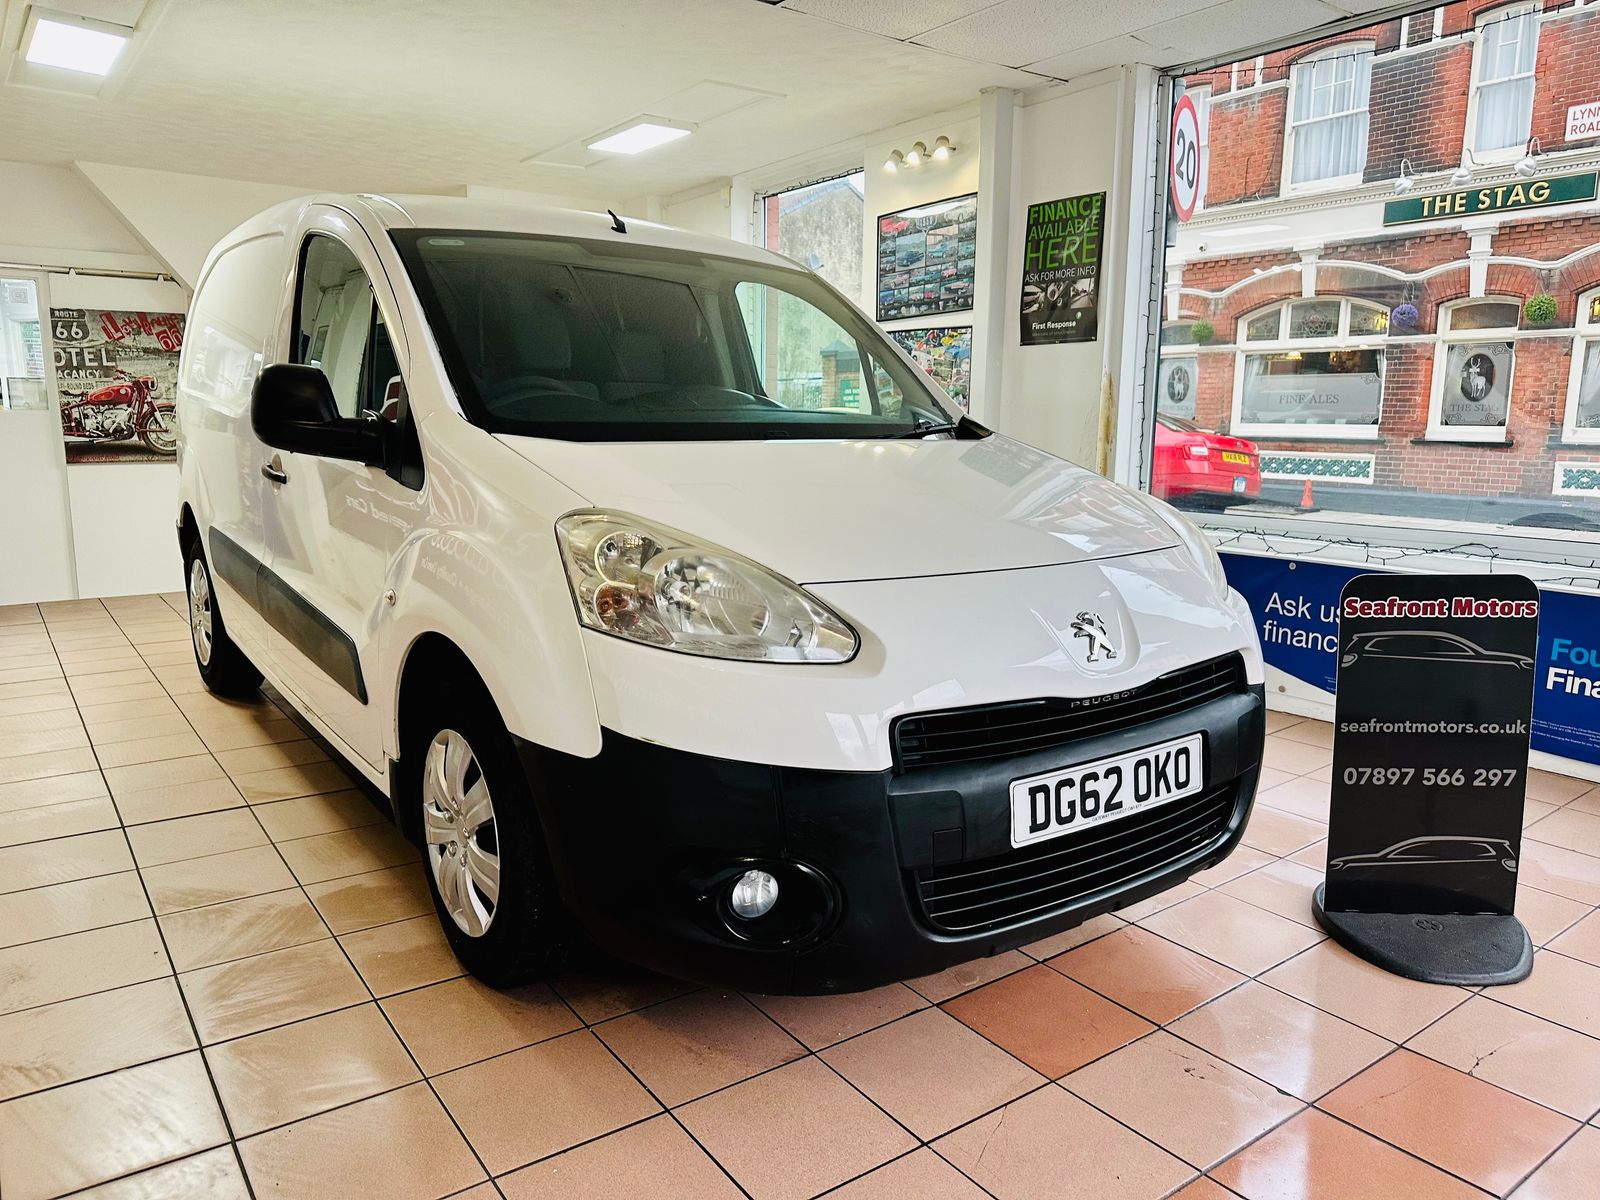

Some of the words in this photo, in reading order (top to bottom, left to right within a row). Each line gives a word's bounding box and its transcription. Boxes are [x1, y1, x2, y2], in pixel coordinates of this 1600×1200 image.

[1573, 106, 1600, 121] LYN
[1176, 128, 1196, 189] 20
[1029, 194, 1102, 225] FINANCE
[1421, 193, 1467, 217] THE
[1477, 181, 1551, 210] STAG
[1028, 215, 1099, 241] AVAILABLE
[1026, 232, 1098, 271] HERE
[1025, 273, 1040, 283] ASK
[1040, 271, 1055, 281] FOR
[1055, 268, 1076, 279] MORE
[1077, 265, 1097, 276] INFO
[55, 321, 84, 339] 66
[1032, 322, 1046, 330] First
[1047, 320, 1077, 329] Response
[1309, 394, 1340, 404] ALES
[1449, 403, 1471, 412] THE
[1264, 592, 1312, 620] Ask
[1344, 597, 1449, 617] Seafront
[1452, 596, 1537, 618] Motors
[1070, 689, 1138, 708] PEUGEOT
[1340, 718, 1527, 735] seafrontmotors.co.uk
[1343, 767, 1415, 786] 07897
[1422, 768, 1466, 786] 566
[1472, 769, 1518, 788] 297
[1028, 765, 1124, 834] DG62
[1133, 746, 1191, 803] OKO
